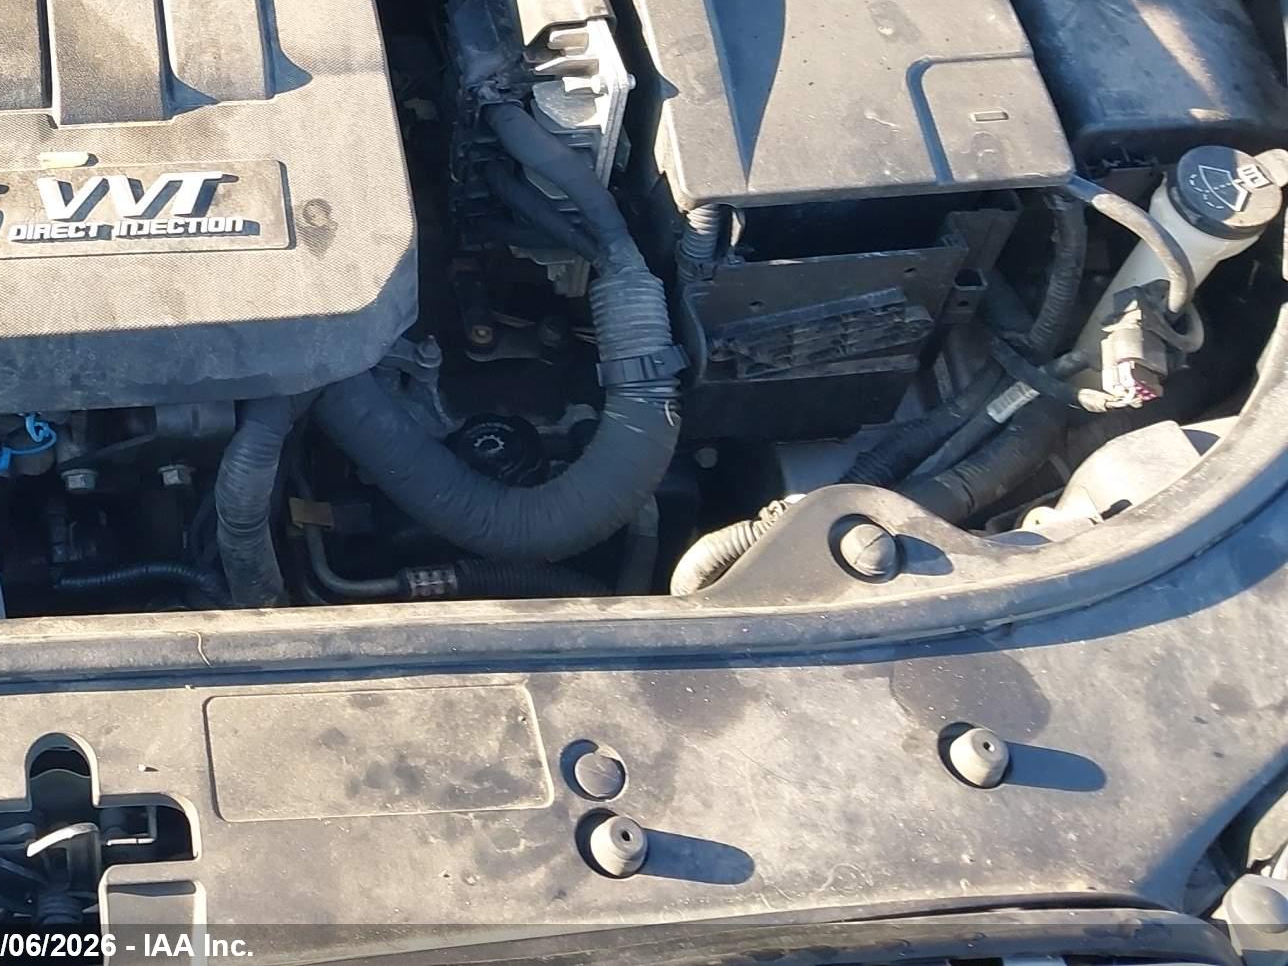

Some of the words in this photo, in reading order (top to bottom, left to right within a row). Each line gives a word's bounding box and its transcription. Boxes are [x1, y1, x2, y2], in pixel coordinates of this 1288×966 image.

[37, 170, 225, 221] VVT
[8, 222, 105, 241] DIRECT
[114, 217, 244, 239] INJECTION
